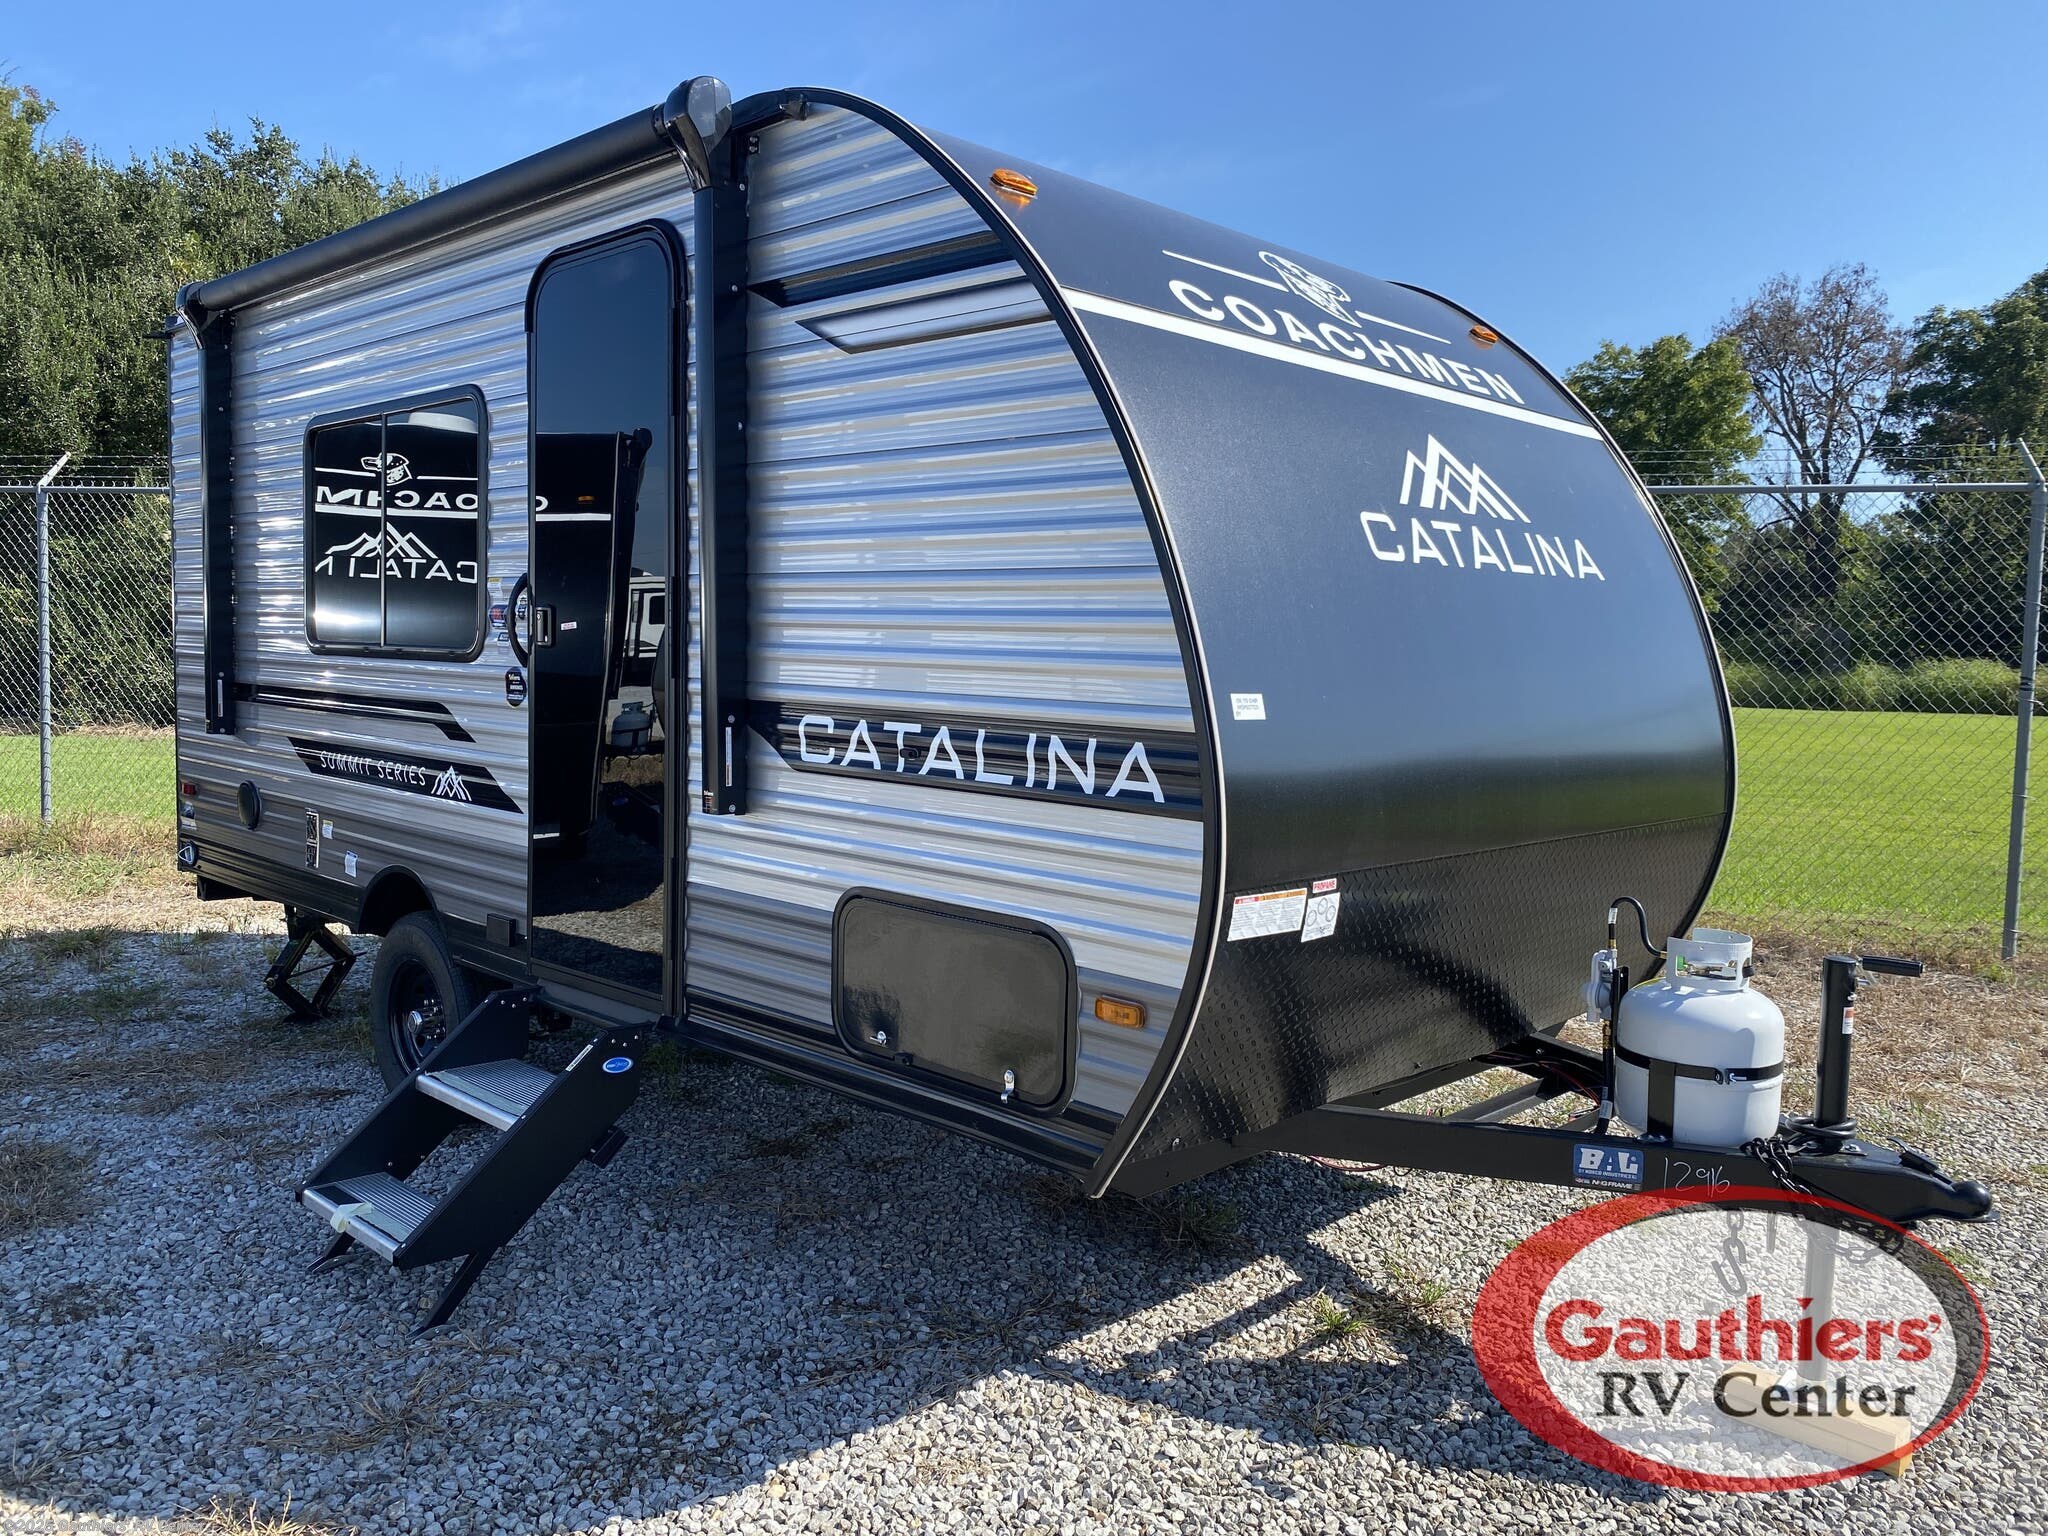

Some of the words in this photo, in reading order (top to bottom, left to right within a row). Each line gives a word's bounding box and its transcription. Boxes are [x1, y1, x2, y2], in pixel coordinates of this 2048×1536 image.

[1169, 280, 1525, 405] COACHMEN
[1360, 511, 1605, 581] CATALINA
[320, 750, 373, 777] SUMMIT
[378, 760, 426, 787] SERIES
[799, 715, 1165, 804] CATALINA
